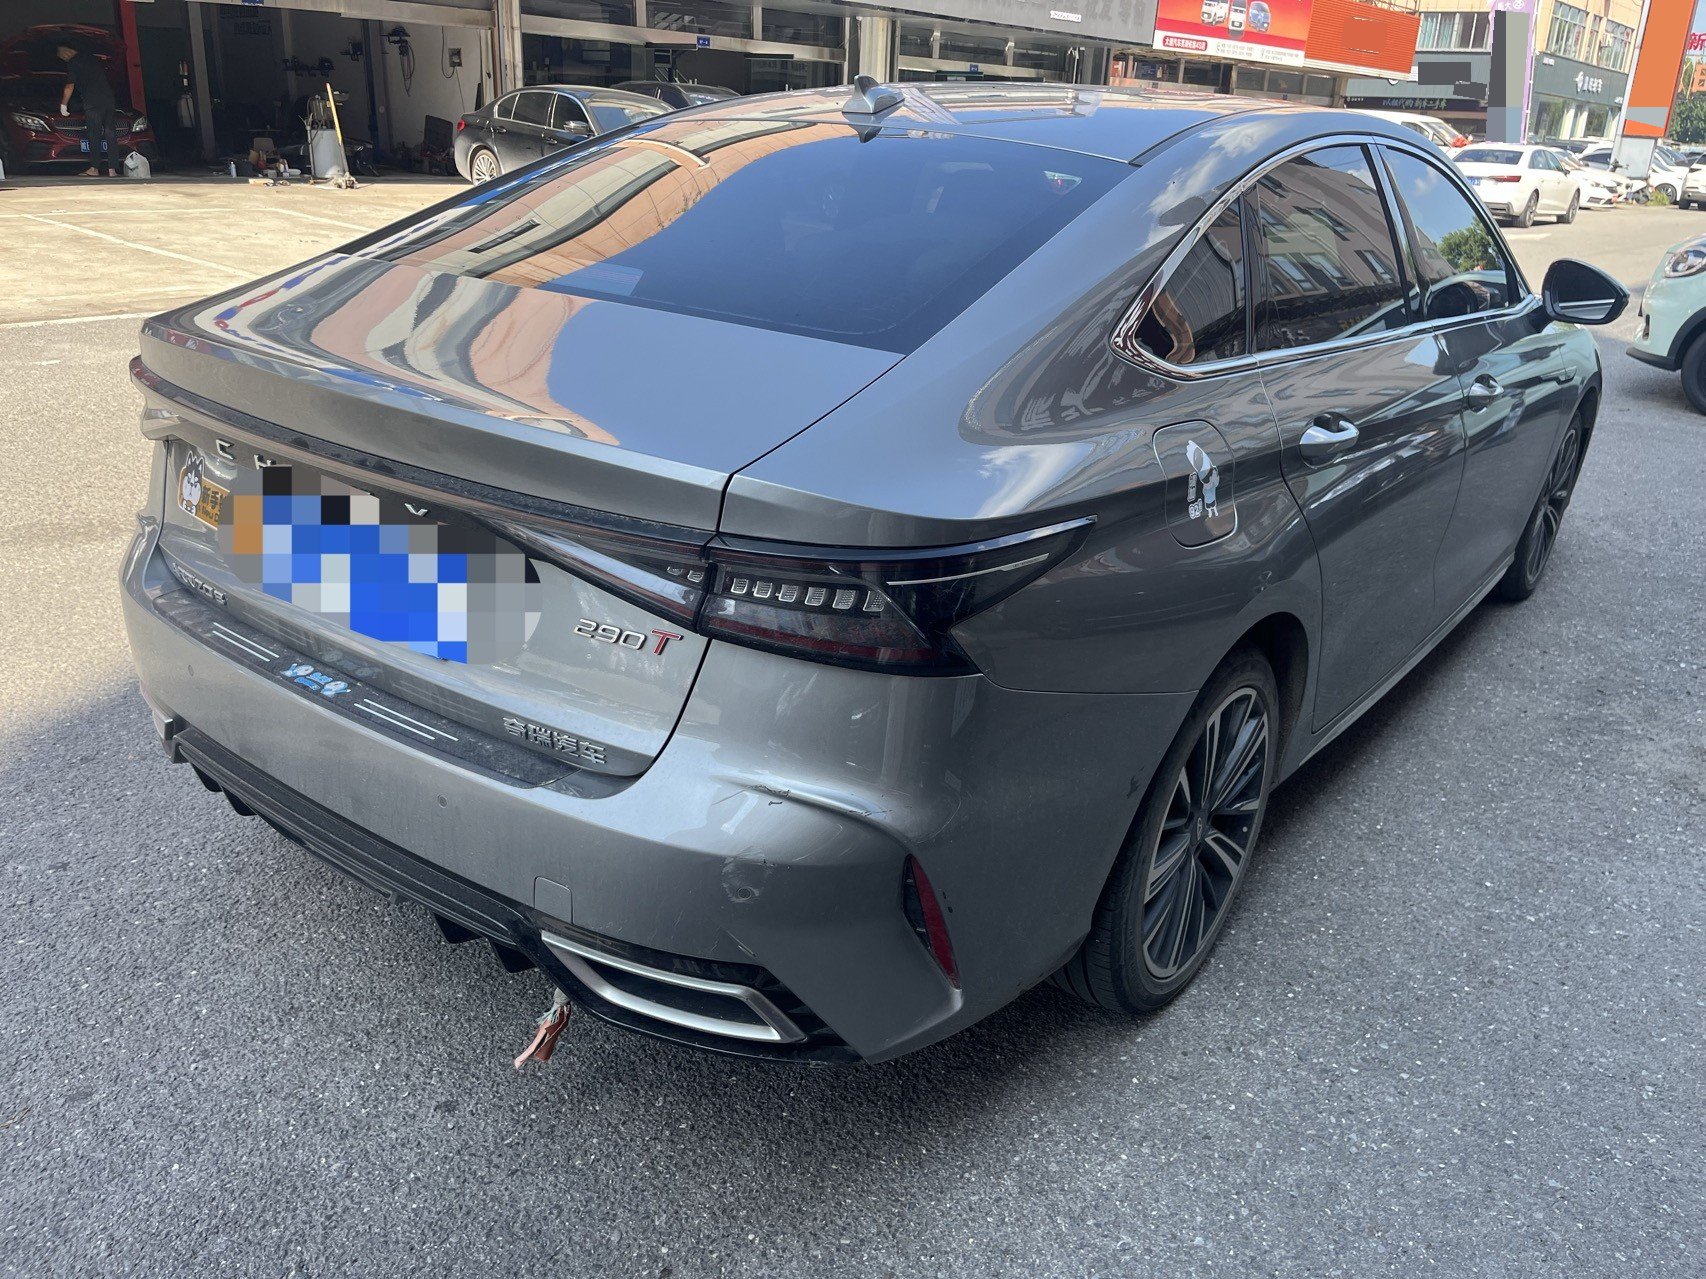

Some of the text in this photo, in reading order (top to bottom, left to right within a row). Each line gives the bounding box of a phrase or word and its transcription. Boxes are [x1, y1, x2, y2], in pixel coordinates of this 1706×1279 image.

[573, 618, 683, 655] 290T
[502, 717, 606, 764] 奇瑞汽车
